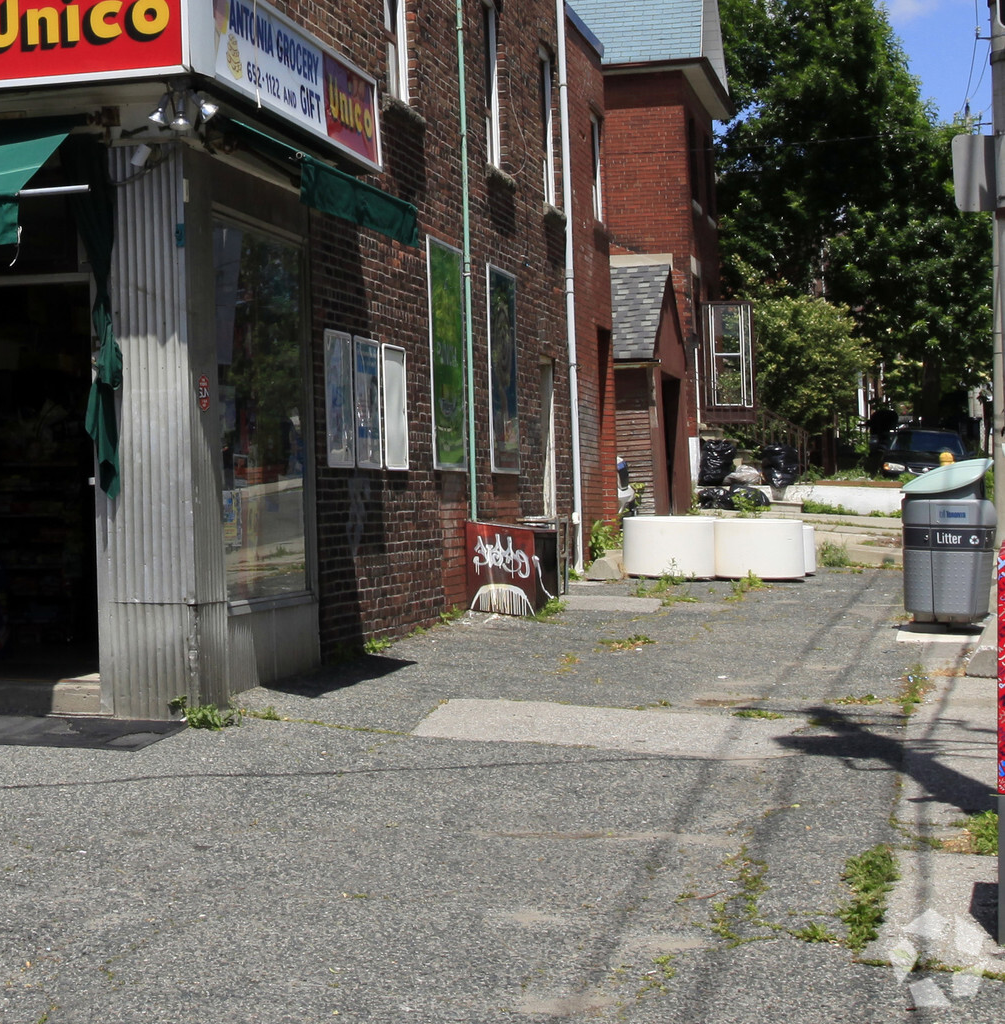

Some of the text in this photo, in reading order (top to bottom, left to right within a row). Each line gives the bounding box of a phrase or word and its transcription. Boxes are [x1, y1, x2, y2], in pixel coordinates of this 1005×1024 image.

[276, 29, 319, 87] GROCERY
[284, 86, 297, 109] AND
[300, 85, 322, 124] GIFT
[328, 77, 373, 142] Unico
[936, 532, 962, 544] Litter
